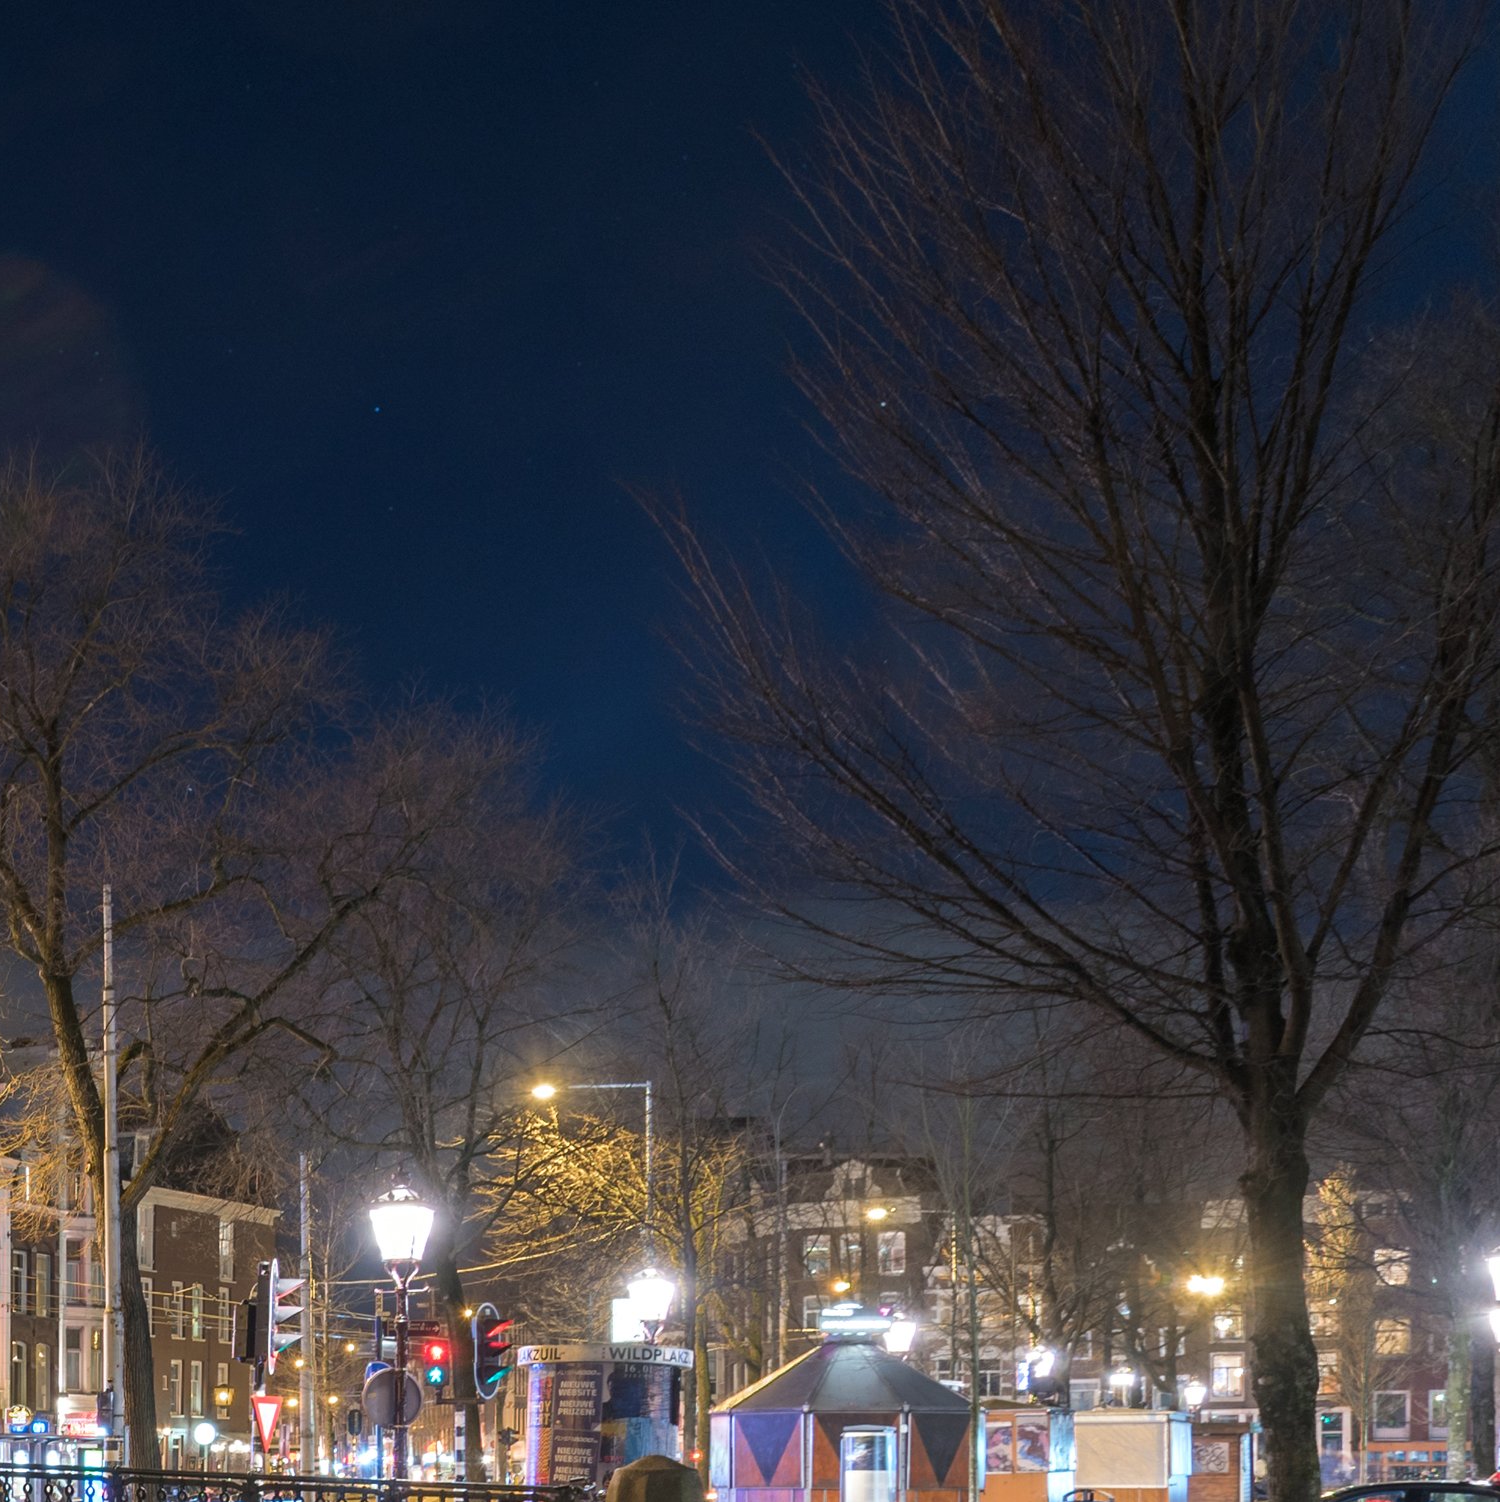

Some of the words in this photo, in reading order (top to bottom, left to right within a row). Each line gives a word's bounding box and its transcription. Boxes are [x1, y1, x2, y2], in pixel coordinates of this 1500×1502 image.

[560, 1380, 595, 1388] NIEUWE
[559, 1400, 594, 1408] NIEUWE
[557, 1447, 592, 1456] NIEUWE
[554, 1455, 593, 1464] WEBSITE
[555, 1466, 590, 1475] NIEUWE
